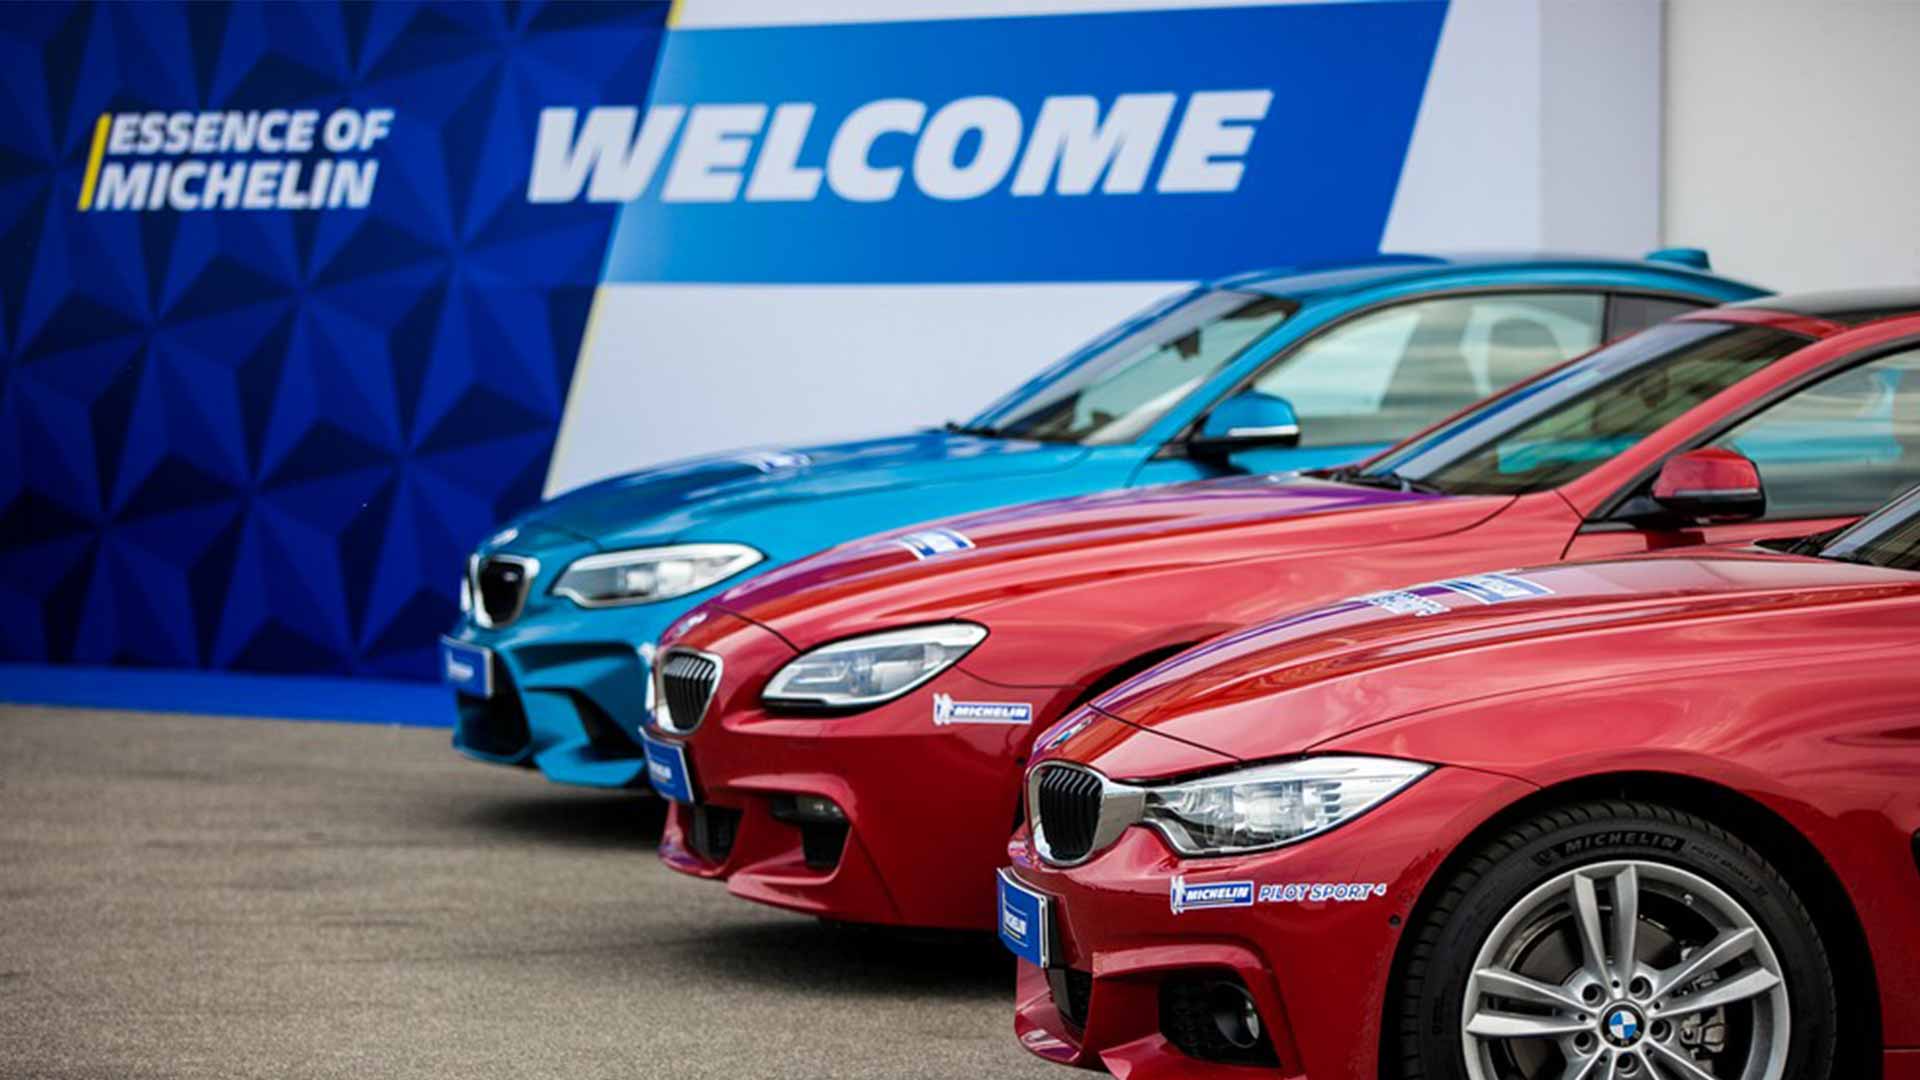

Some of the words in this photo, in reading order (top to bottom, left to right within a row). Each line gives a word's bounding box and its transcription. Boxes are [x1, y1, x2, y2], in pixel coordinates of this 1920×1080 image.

[108, 110, 319, 154] ESSENCE
[323, 108, 395, 151] OF
[527, 90, 1273, 203] WELCOME
[95, 159, 379, 210] MICHELIN
[1564, 831, 1678, 855] MICHELIN
[1186, 886, 1249, 900] MICHELIN
[1258, 884, 1307, 902] PILOT
[1309, 884, 1371, 901] SPORT
